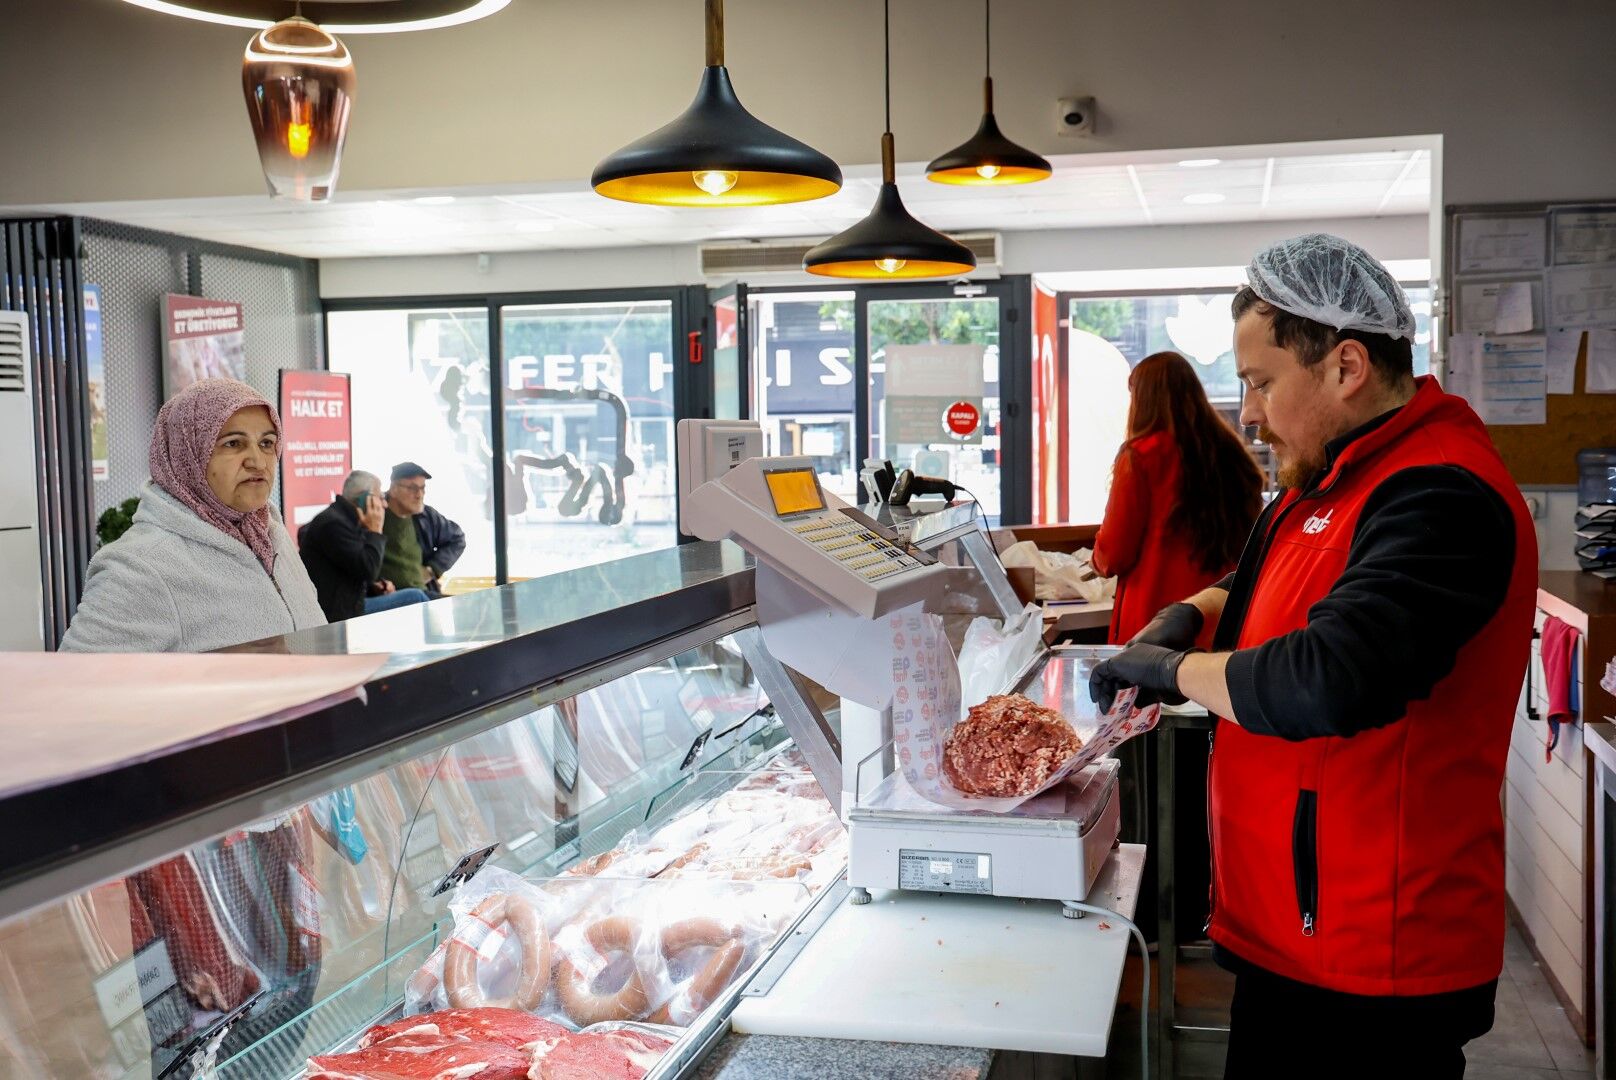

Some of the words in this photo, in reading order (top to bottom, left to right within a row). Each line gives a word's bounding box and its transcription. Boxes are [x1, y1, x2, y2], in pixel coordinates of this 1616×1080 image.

[291, 400, 327, 418] HALK
[328, 400, 344, 418] ET
[950, 412, 975, 420] KAPALI
